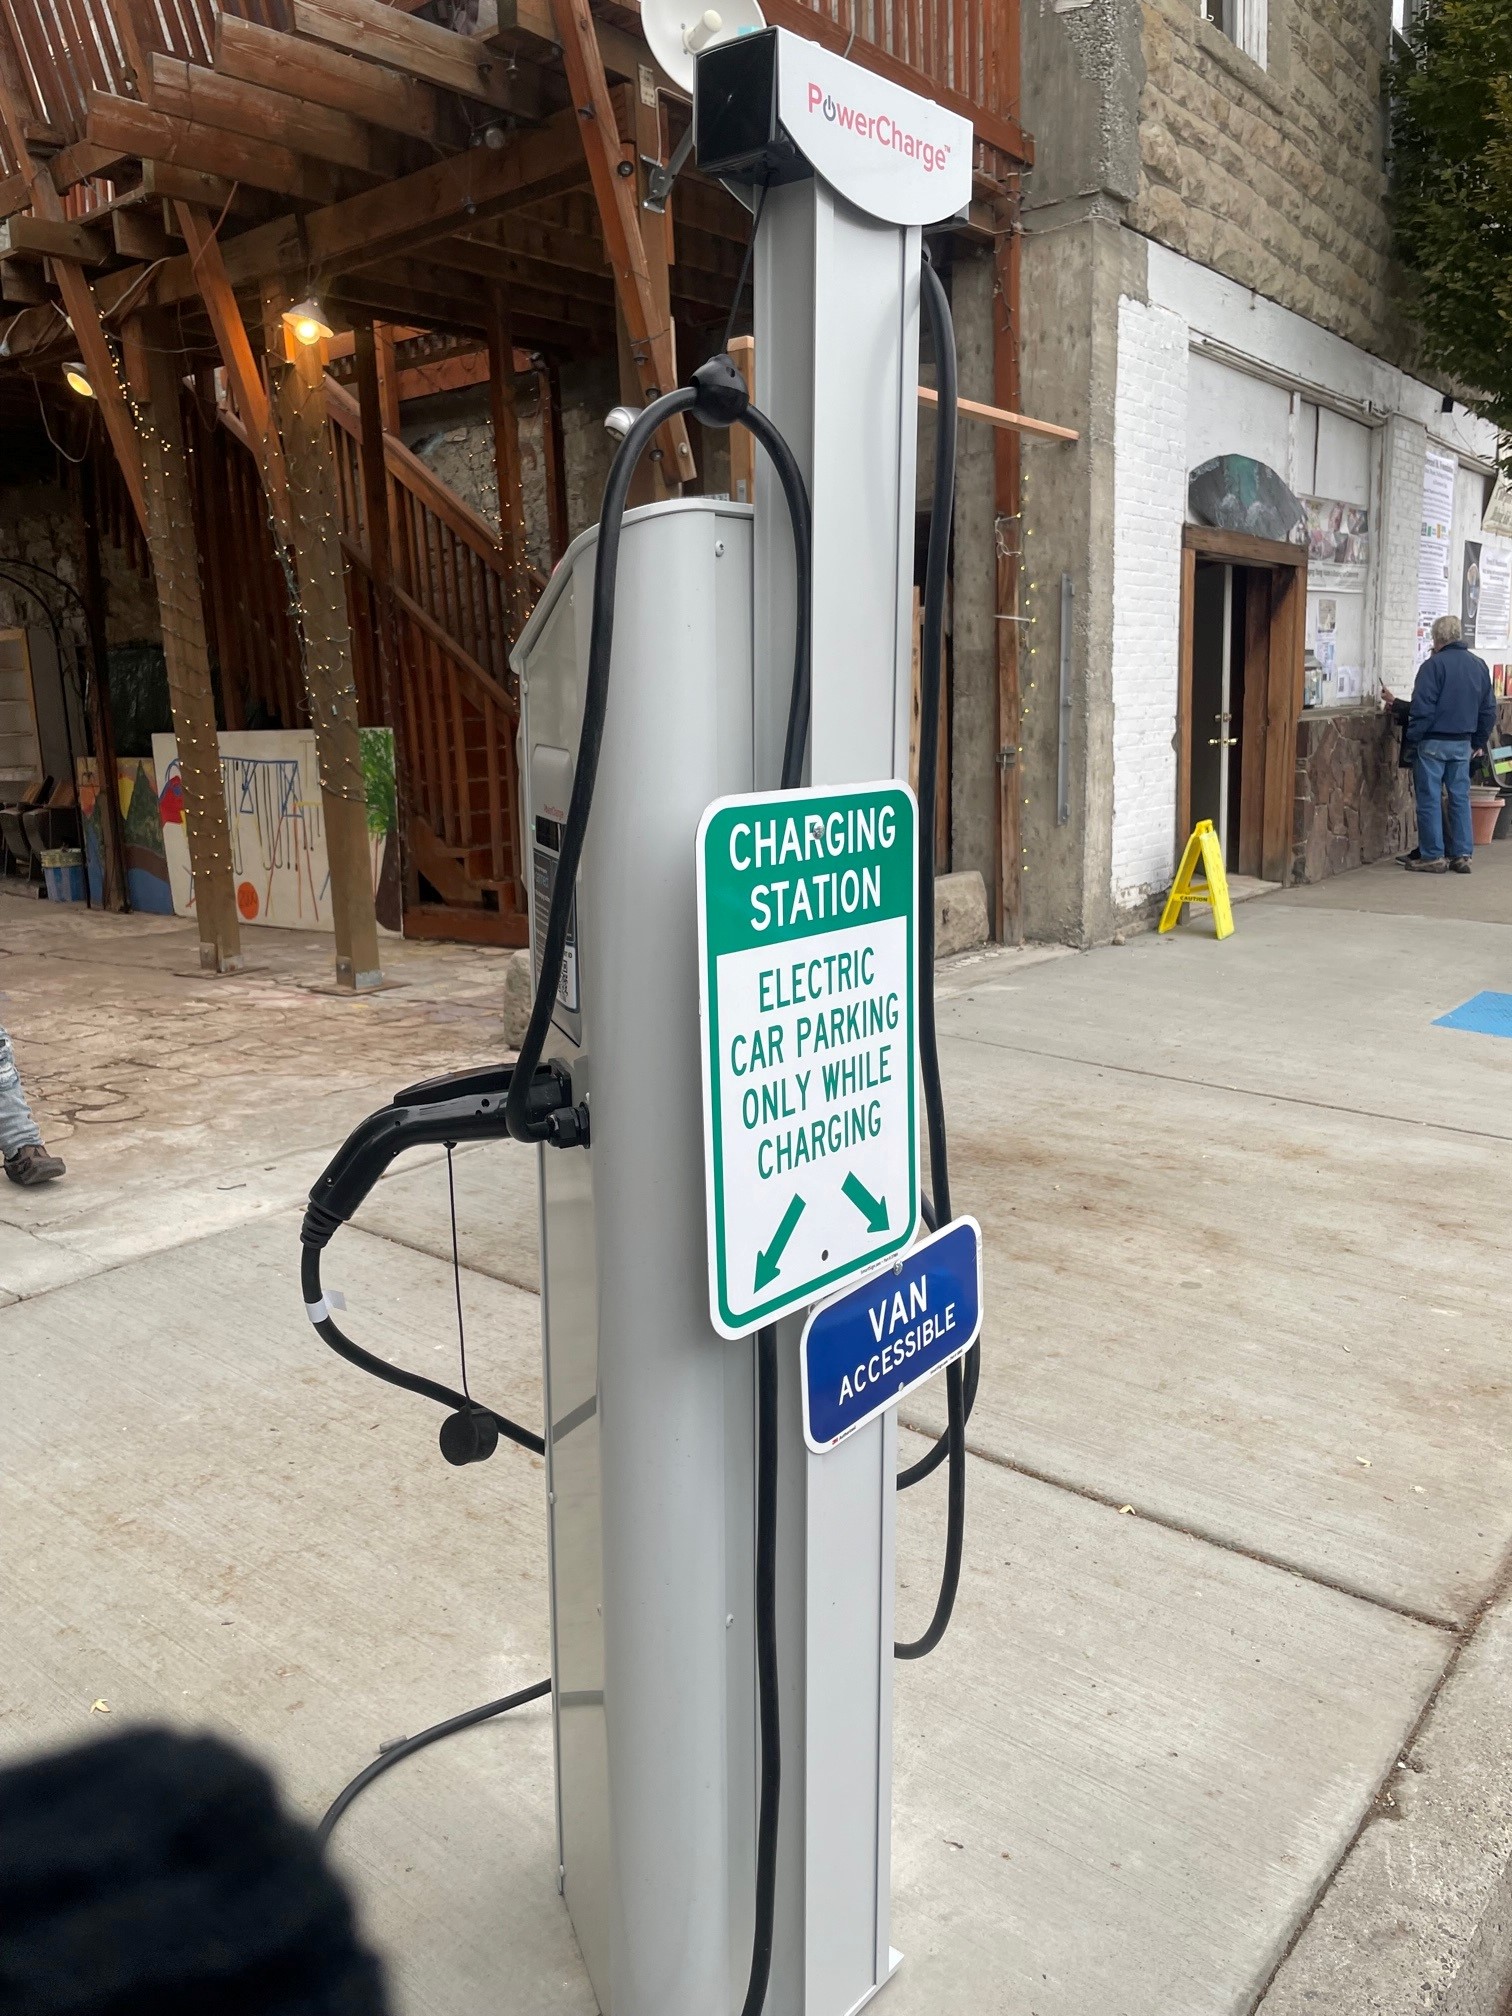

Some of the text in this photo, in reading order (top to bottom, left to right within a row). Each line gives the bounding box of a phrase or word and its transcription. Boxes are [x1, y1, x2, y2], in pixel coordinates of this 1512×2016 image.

[729, 805, 896, 871] CHARGING
[751, 865, 881, 931] STATION
[759, 947, 874, 1013] ELECTRIC
[731, 992, 899, 1077] CAR PARKING
[742, 1045, 892, 1130] ONLY WHILE
[758, 1100, 881, 1179] CHARGING
[868, 1274, 927, 1343] VAN
[838, 1302, 956, 1406] ACCESSIBLE
